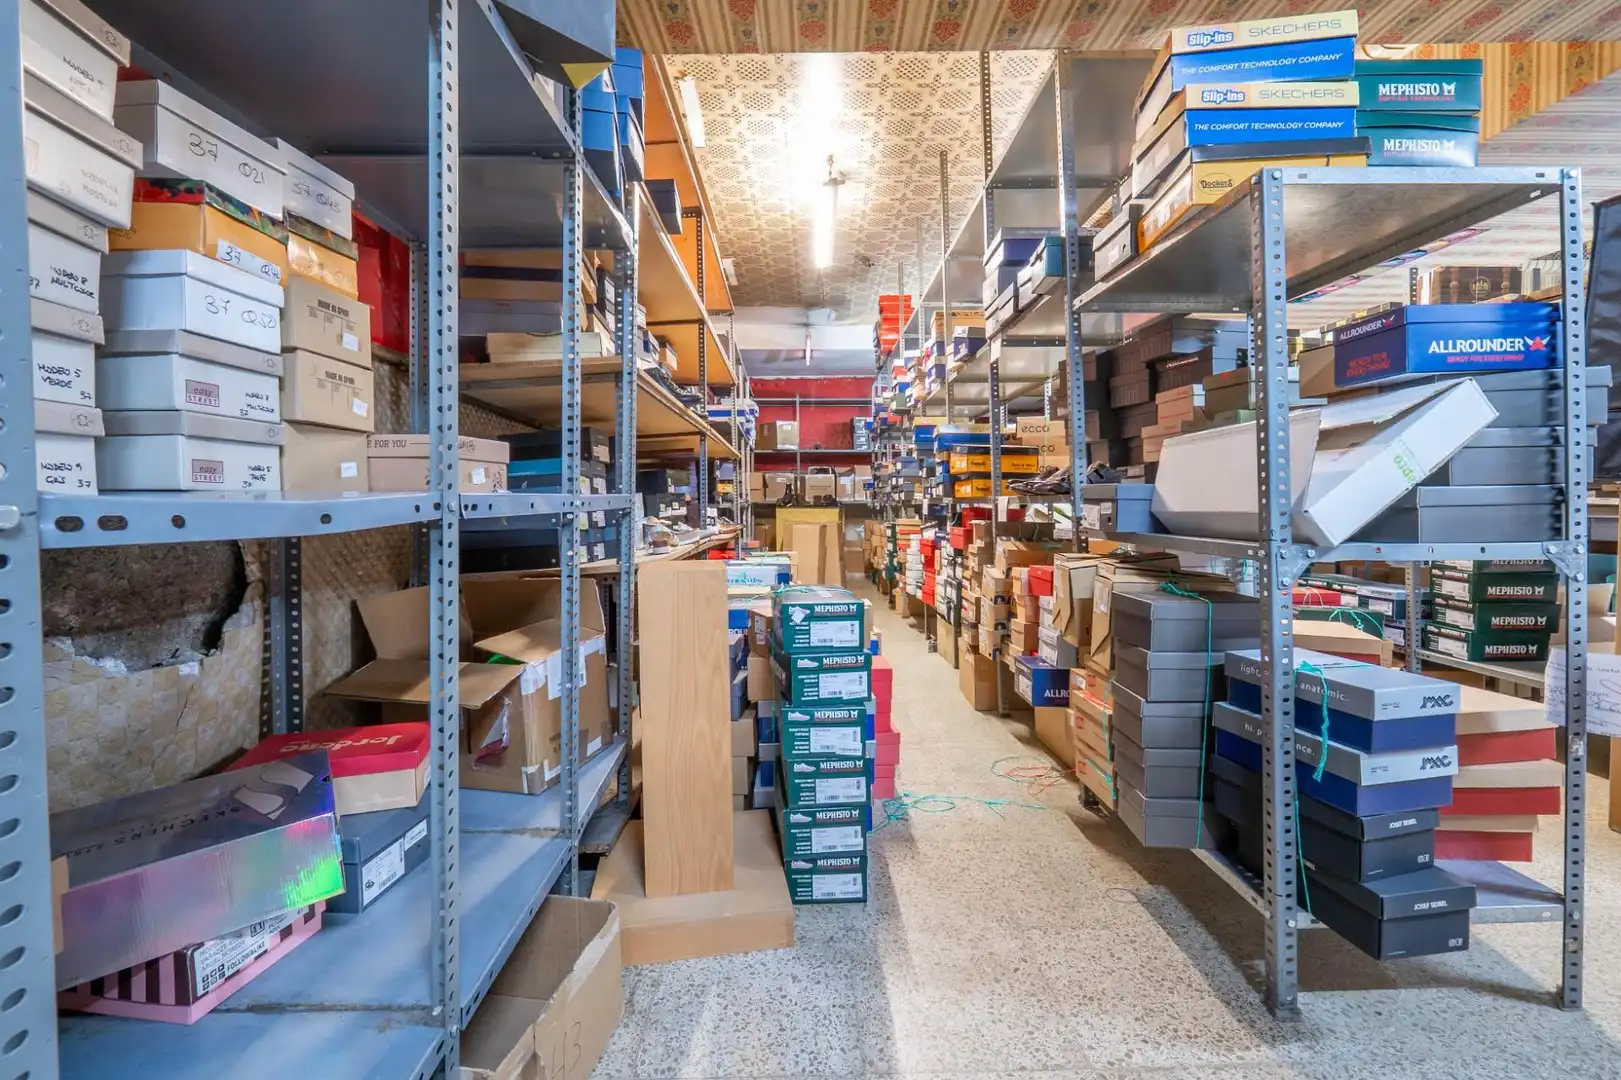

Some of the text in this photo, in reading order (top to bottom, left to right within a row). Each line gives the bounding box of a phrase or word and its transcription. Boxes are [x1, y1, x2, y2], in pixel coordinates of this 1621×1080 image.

[1187, 19, 1342, 47] Slip-ins SKECHERS
[1180, 53, 1342, 75] THE COMFORT TECHNOLOGY COMPANY
[1378, 83, 1440, 96] MEPHISTO
[1202, 88, 1345, 104] Slip-ins SKECHERS
[1194, 121, 1344, 131] THE COMFORT TECHNOLOGY COMPANY
[189, 132, 218, 162] 37
[1383, 138, 1440, 151] MEPHISTO
[1200, 179, 1233, 189] Dockers
[221, 245, 242, 265] 37
[204, 294, 231, 315] 37
[1339, 319, 1382, 341] ALLROUNDER
[1428, 337, 1525, 354] ALLROUNDER
[193, 387, 213, 398] easy
[187, 395, 218, 406] STREET
[1021, 425, 1050, 433] ecco
[374, 440, 390, 448] FOR
[391, 440, 407, 448] YOU
[199, 466, 217, 475] easy
[194, 474, 223, 482] STREET
[1487, 586, 1532, 596] MEPHISTO
[814, 604, 848, 613] MEPHISTO
[1491, 616, 1535, 625] MEPHISTO
[1485, 644, 1527, 654] MEPHISTO
[822, 655, 856, 665] MEPHISTO
[814, 710, 849, 719] MEPHISTO
[820, 760, 855, 769] MEPHISTO
[816, 810, 851, 820] MEPHISTO
[113, 805, 241, 845] SKECHERS
[817, 858, 851, 867] MEPHISTO
